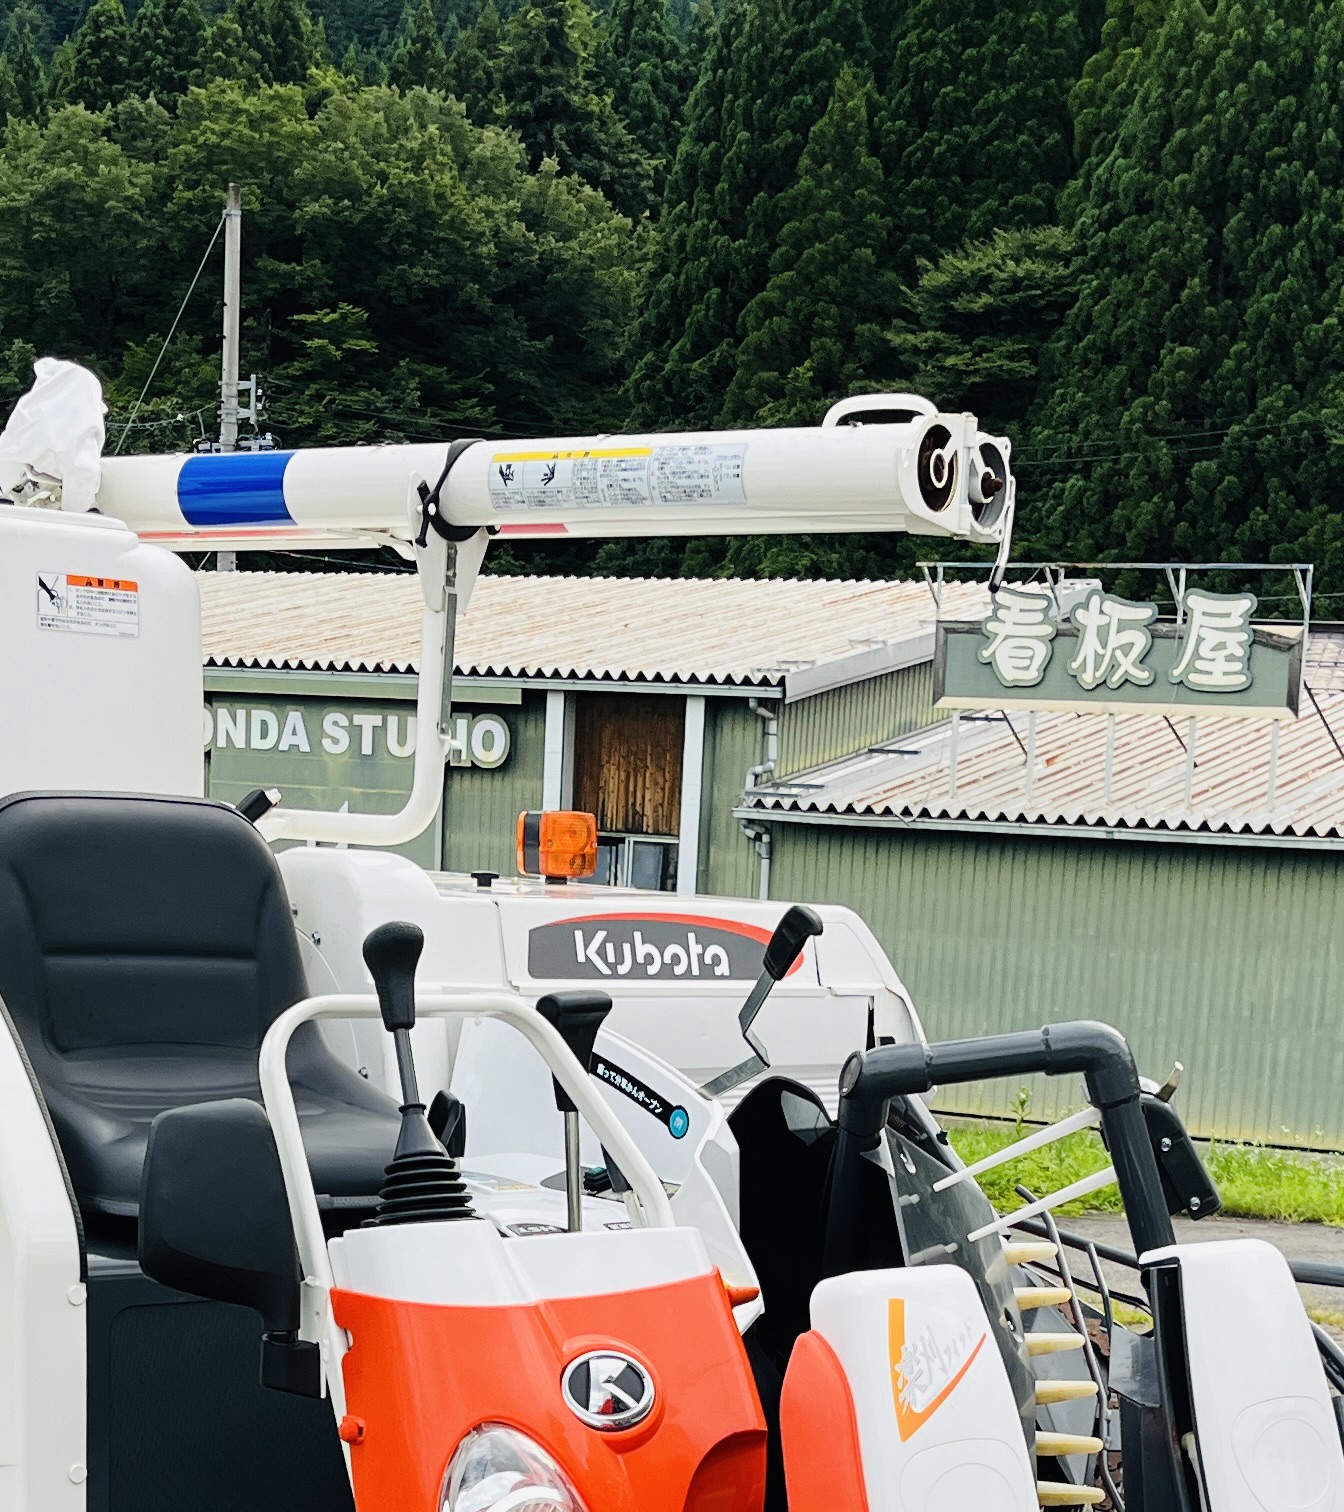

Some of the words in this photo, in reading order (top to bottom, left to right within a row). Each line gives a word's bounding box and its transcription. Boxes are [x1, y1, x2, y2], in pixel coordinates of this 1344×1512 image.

[981, 591, 1253, 687] 看板屋
[321, 711, 507, 763] STUIO
[574, 929, 731, 977] Kubota
